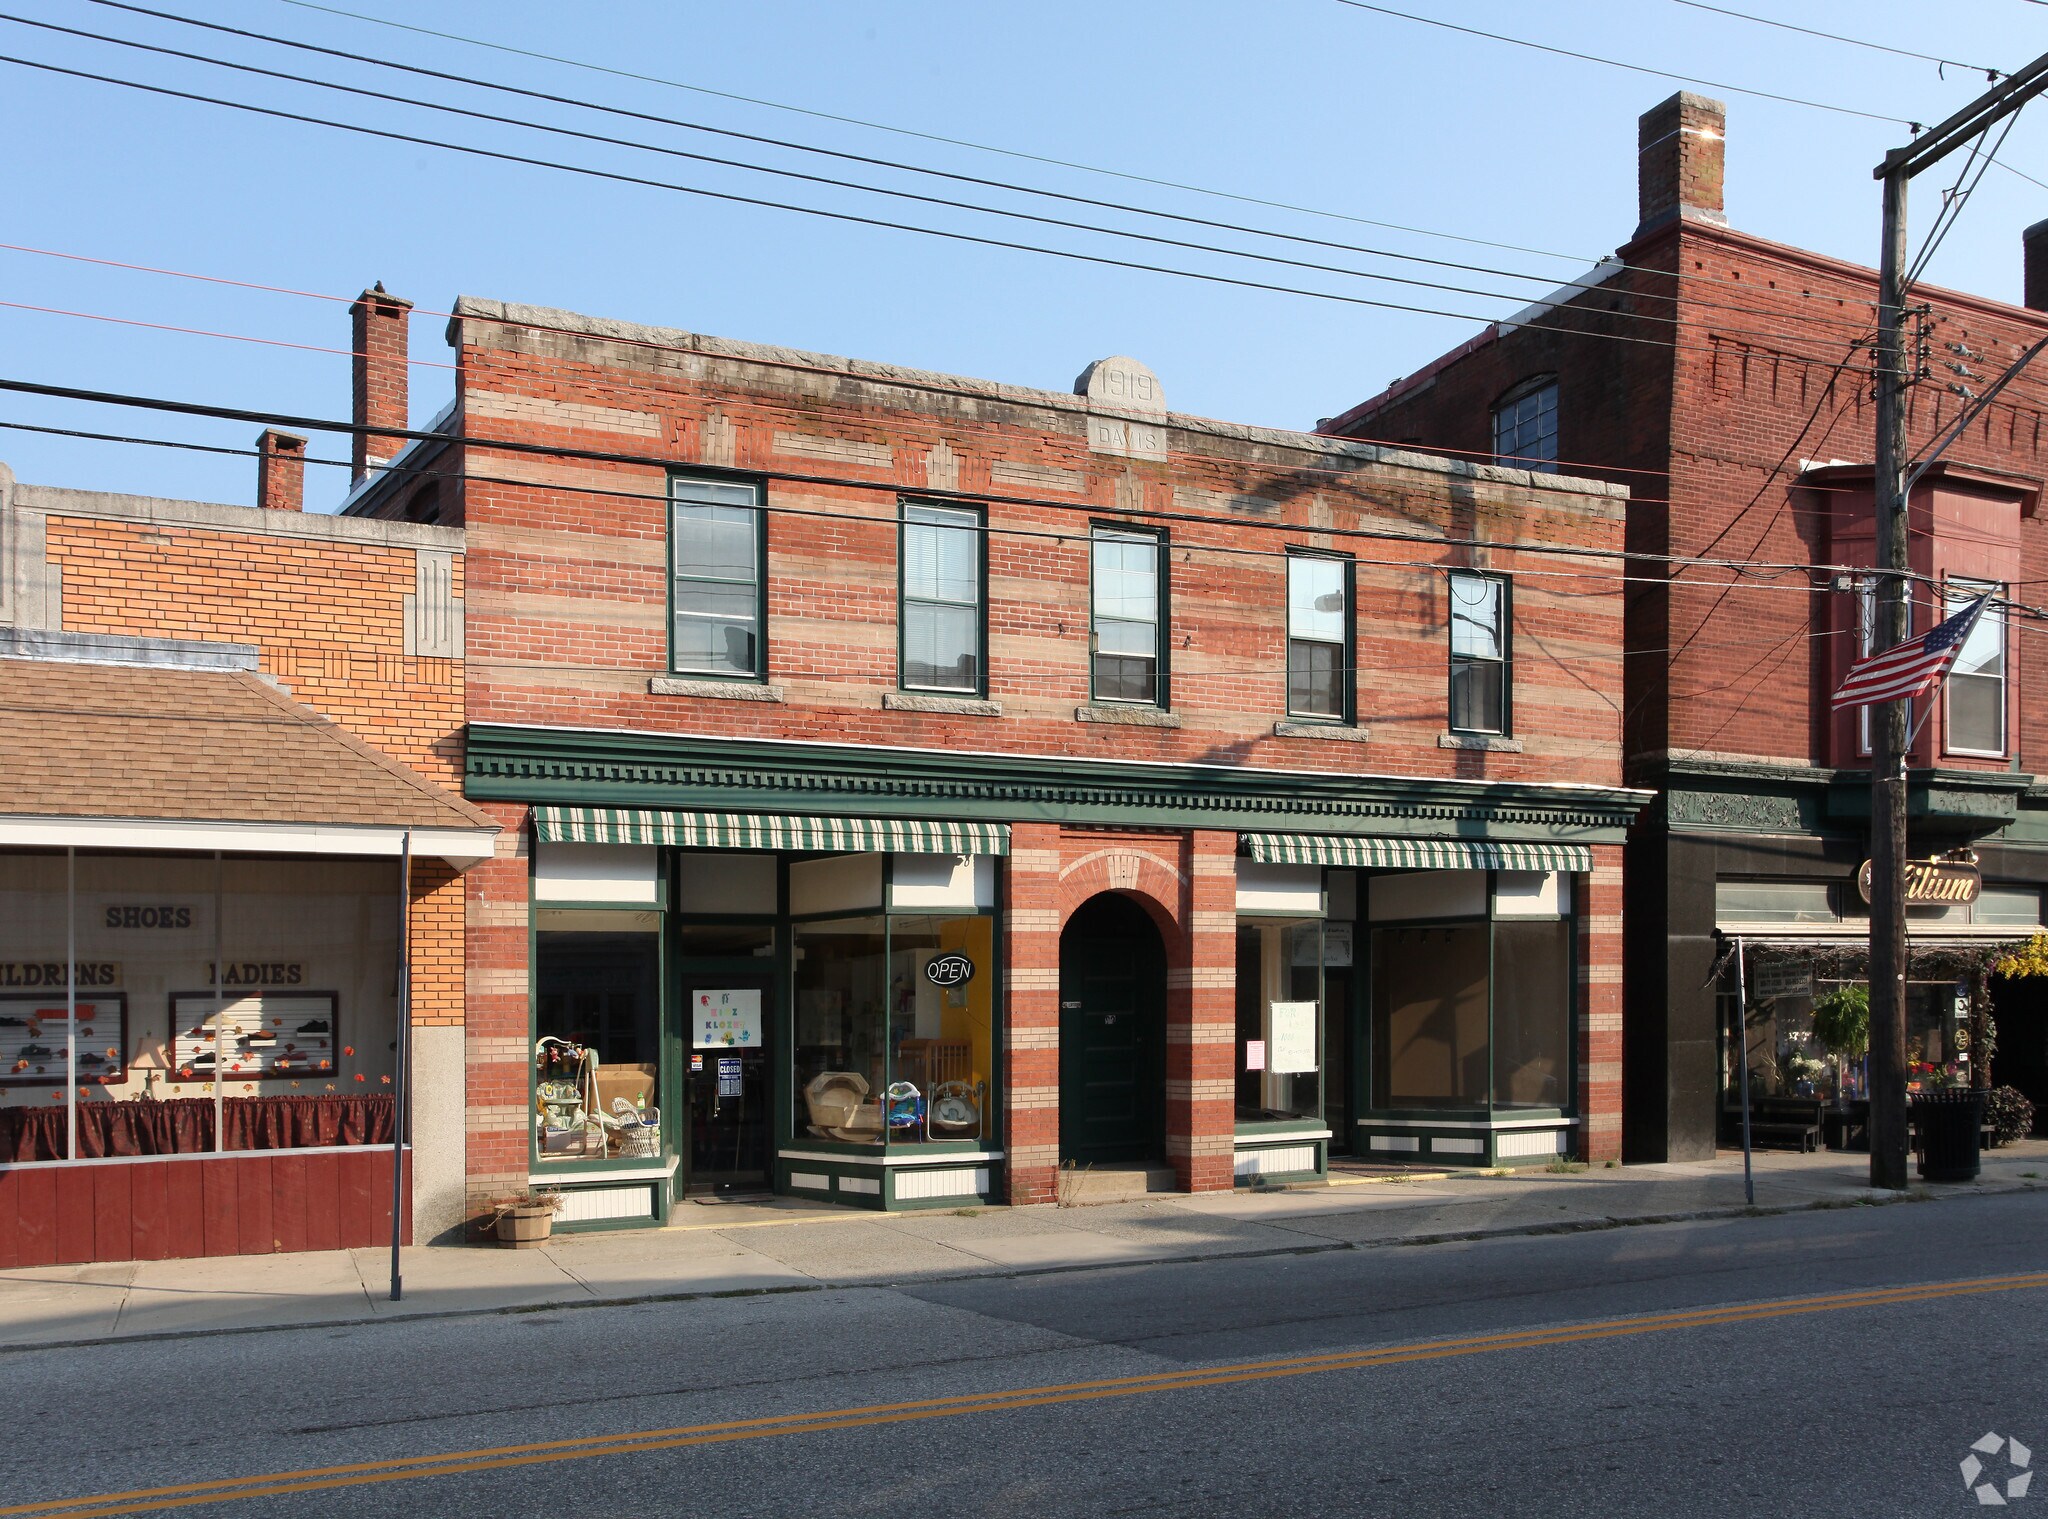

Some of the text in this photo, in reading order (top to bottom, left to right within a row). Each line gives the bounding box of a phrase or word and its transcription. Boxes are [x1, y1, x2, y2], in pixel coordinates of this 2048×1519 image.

[1102, 367, 1153, 401] 1919
[1098, 426, 1156, 450] DAVIS
[106, 906, 192, 929] SHOES
[209, 963, 302, 985] LADIES
[927, 962, 971, 979] OPEN
[719, 1065, 741, 1074] CLOSED
